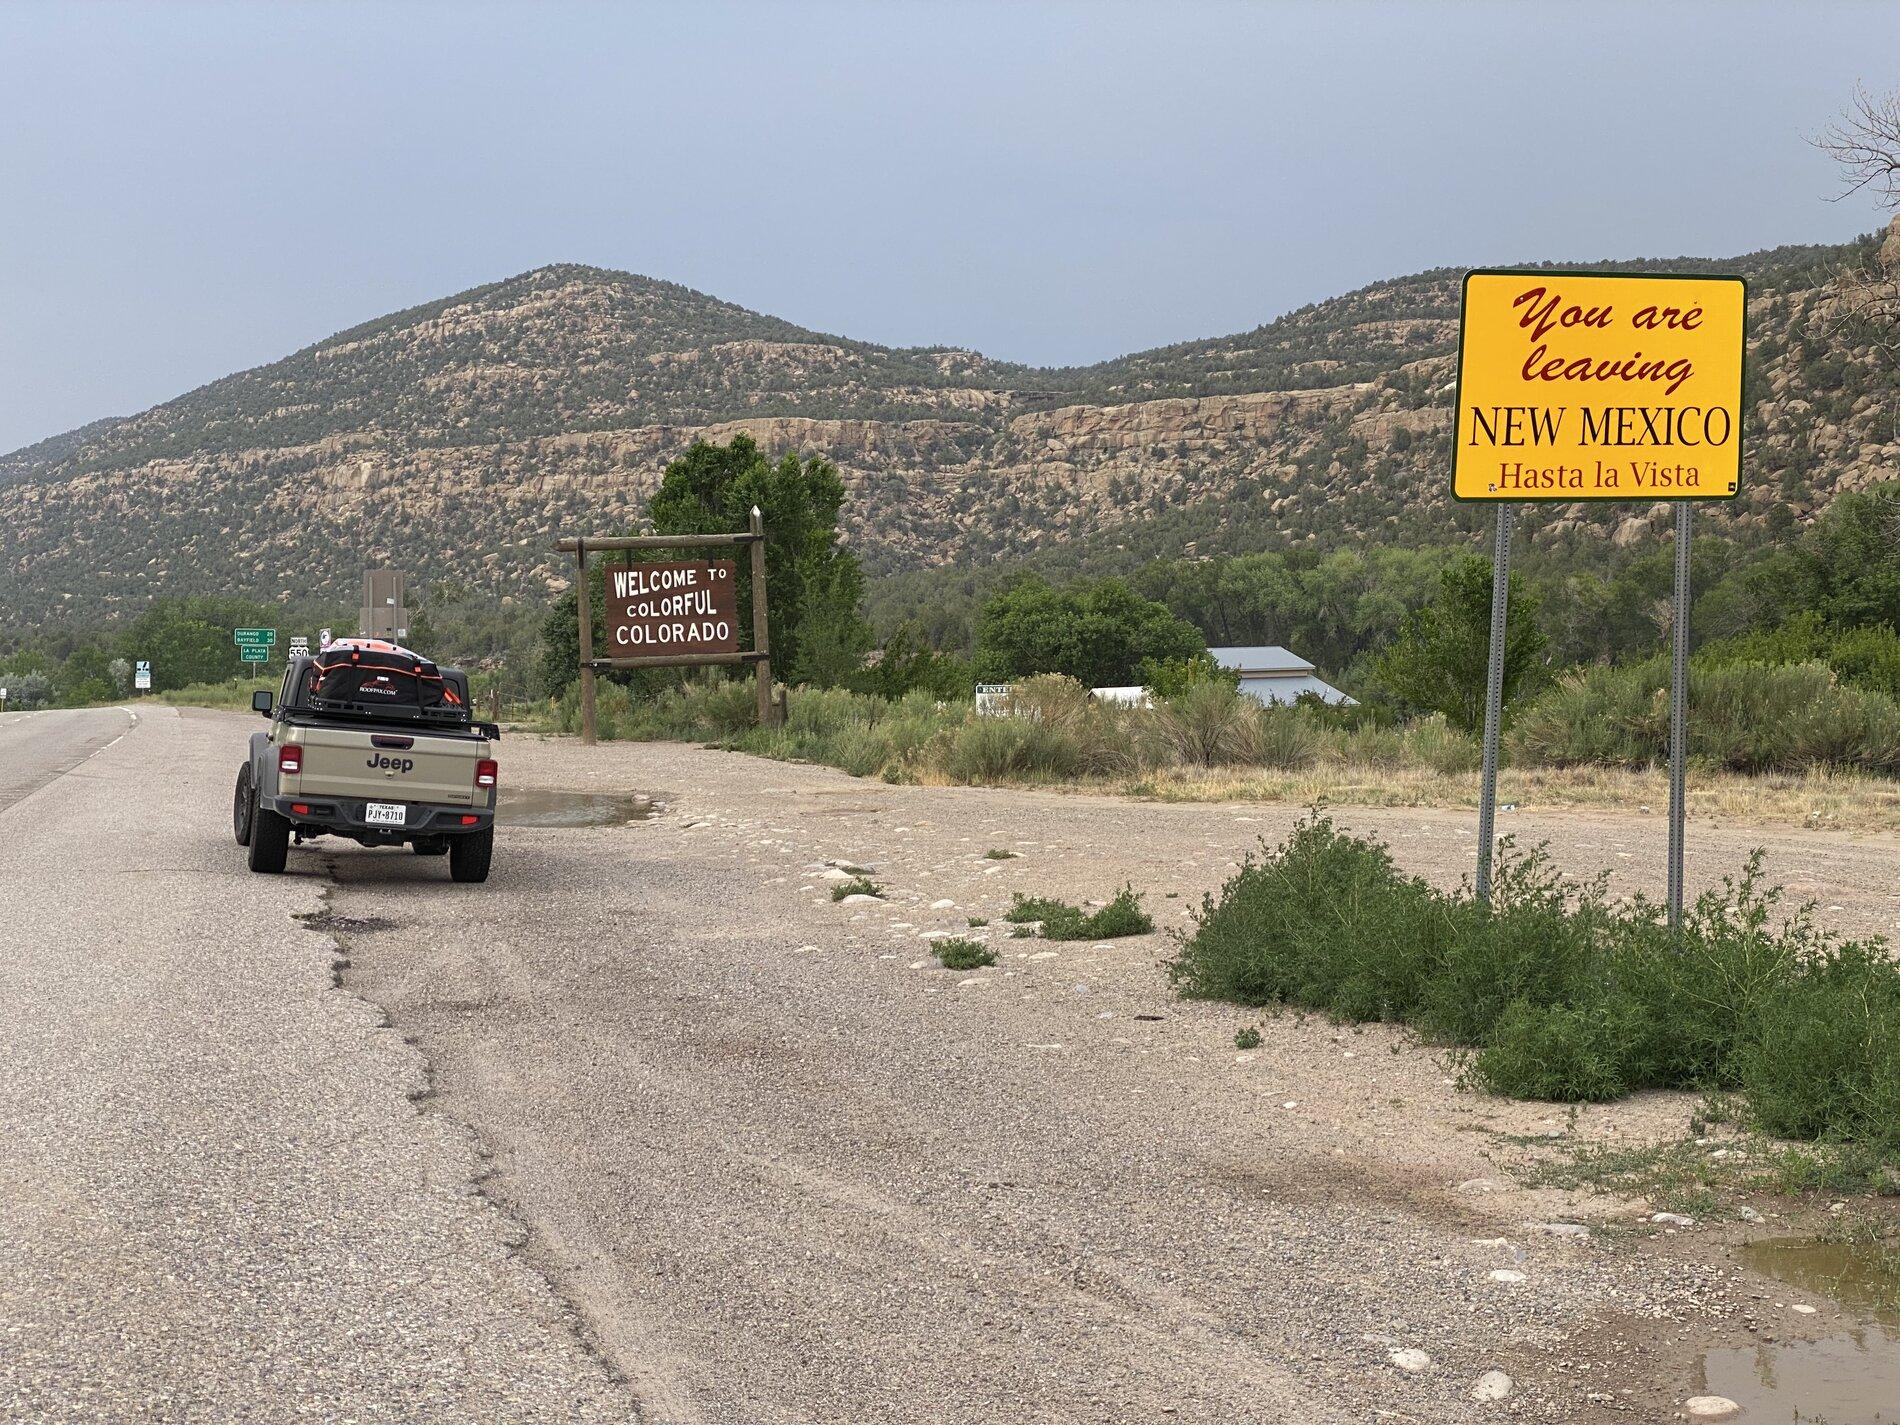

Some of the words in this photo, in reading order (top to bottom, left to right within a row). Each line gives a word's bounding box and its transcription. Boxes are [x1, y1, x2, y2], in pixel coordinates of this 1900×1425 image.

[1512, 287, 1613, 342] You
[1632, 306, 1703, 330] are
[1522, 344, 1694, 395] leaving
[1469, 407, 1566, 446] NEW
[1578, 407, 1731, 446] MEXICO
[1499, 463, 1584, 489] Hasta
[1594, 461, 1619, 488] la
[1630, 462, 1700, 487] Vista
[614, 569, 697, 598] WELCOME
[708, 568, 727, 581] TO
[626, 589, 717, 617] COLORFUL
[616, 621, 729, 645] COLORADO
[366, 753, 414, 773] Jeep
